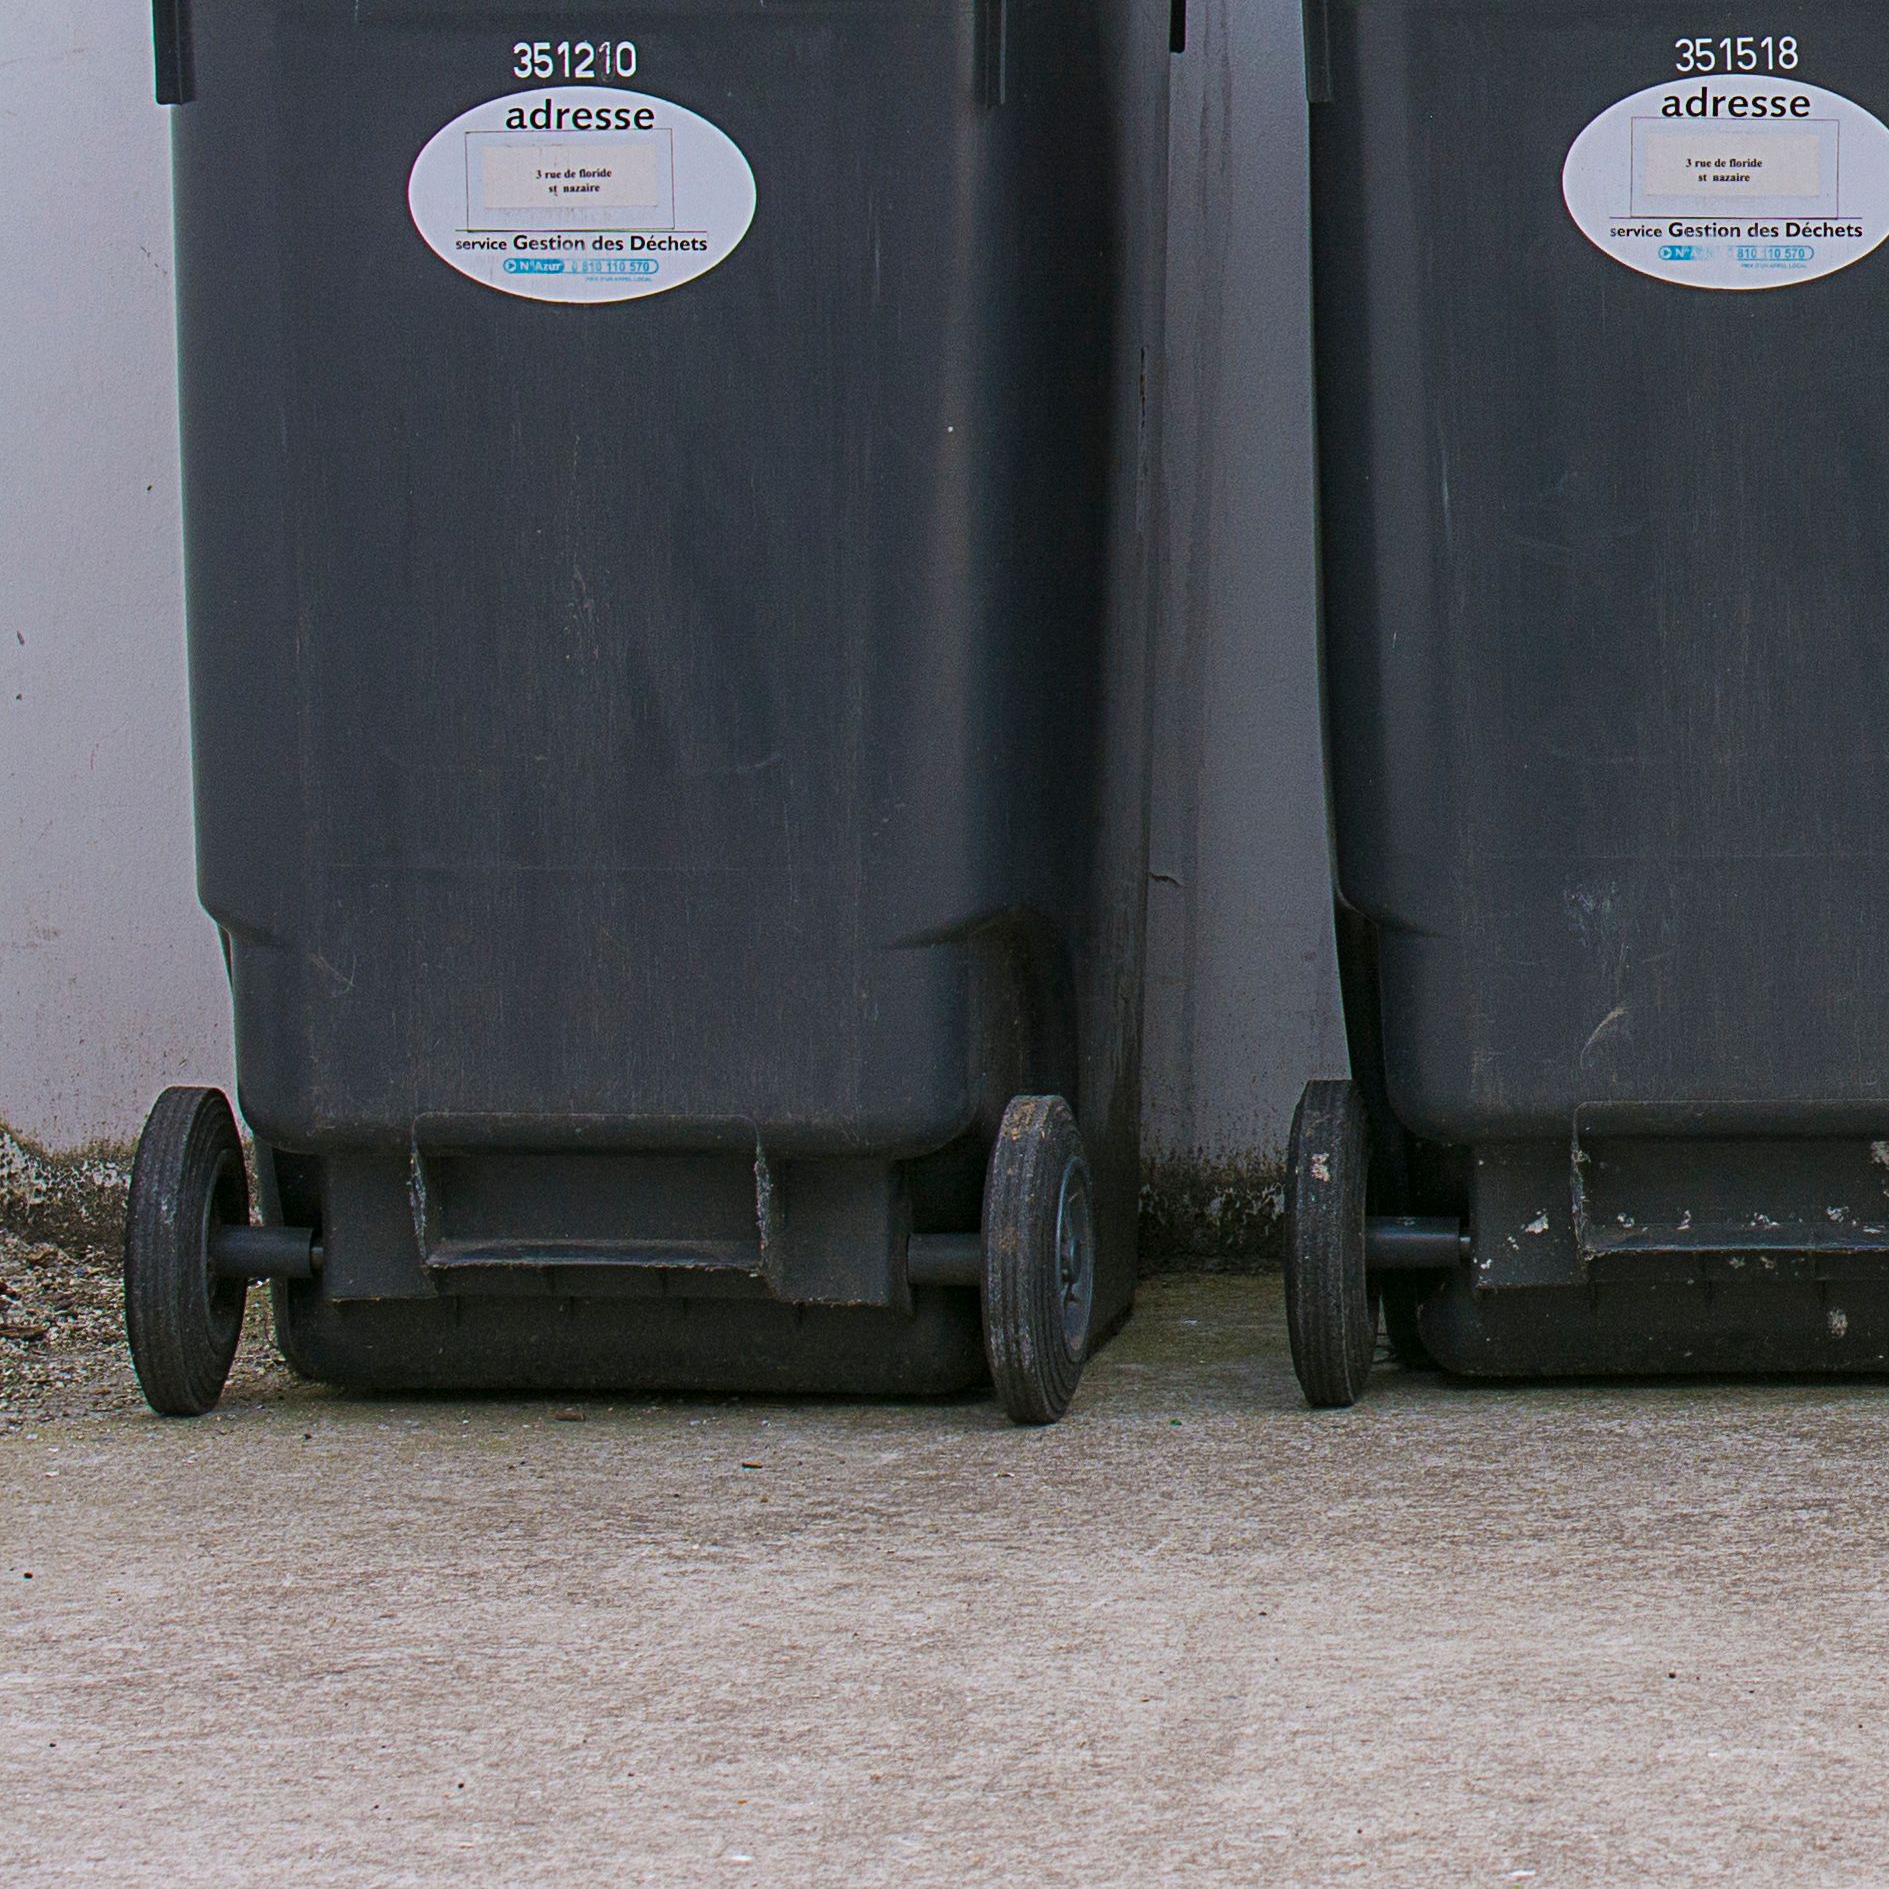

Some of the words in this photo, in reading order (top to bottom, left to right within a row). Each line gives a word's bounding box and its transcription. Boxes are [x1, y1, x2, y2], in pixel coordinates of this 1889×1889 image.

[513, 41, 637, 78] 351210
[1675, 36, 1799, 72] 351518
[1661, 86, 1811, 118] adresse
[505, 99, 655, 130] adresse
[1686, 158, 1692, 168] 3
[1695, 160, 1712, 168] rue
[1714, 158, 1726, 168] de
[1729, 158, 1763, 168] floride
[536, 169, 542, 179] 3
[545, 171, 561, 179] rue
[564, 169, 577, 179] de
[579, 168, 612, 179] floride
[1698, 173, 1707, 183] st
[1713, 172, 1750, 183] nazaire
[563, 183, 600, 193] nazaire
[1610, 225, 1662, 238] service
[1668, 221, 1741, 238] Gestion
[1748, 221, 1779, 238] des
[1785, 221, 1863, 238] Déchets
[456, 238, 507, 251] service
[513, 235, 585, 251] Gestion
[592, 234, 624, 251] des
[630, 234, 708, 251] Déchets
[1785, 248, 1805, 259] 570
[606, 261, 627, 272] 110
[630, 261, 650, 272] 570
